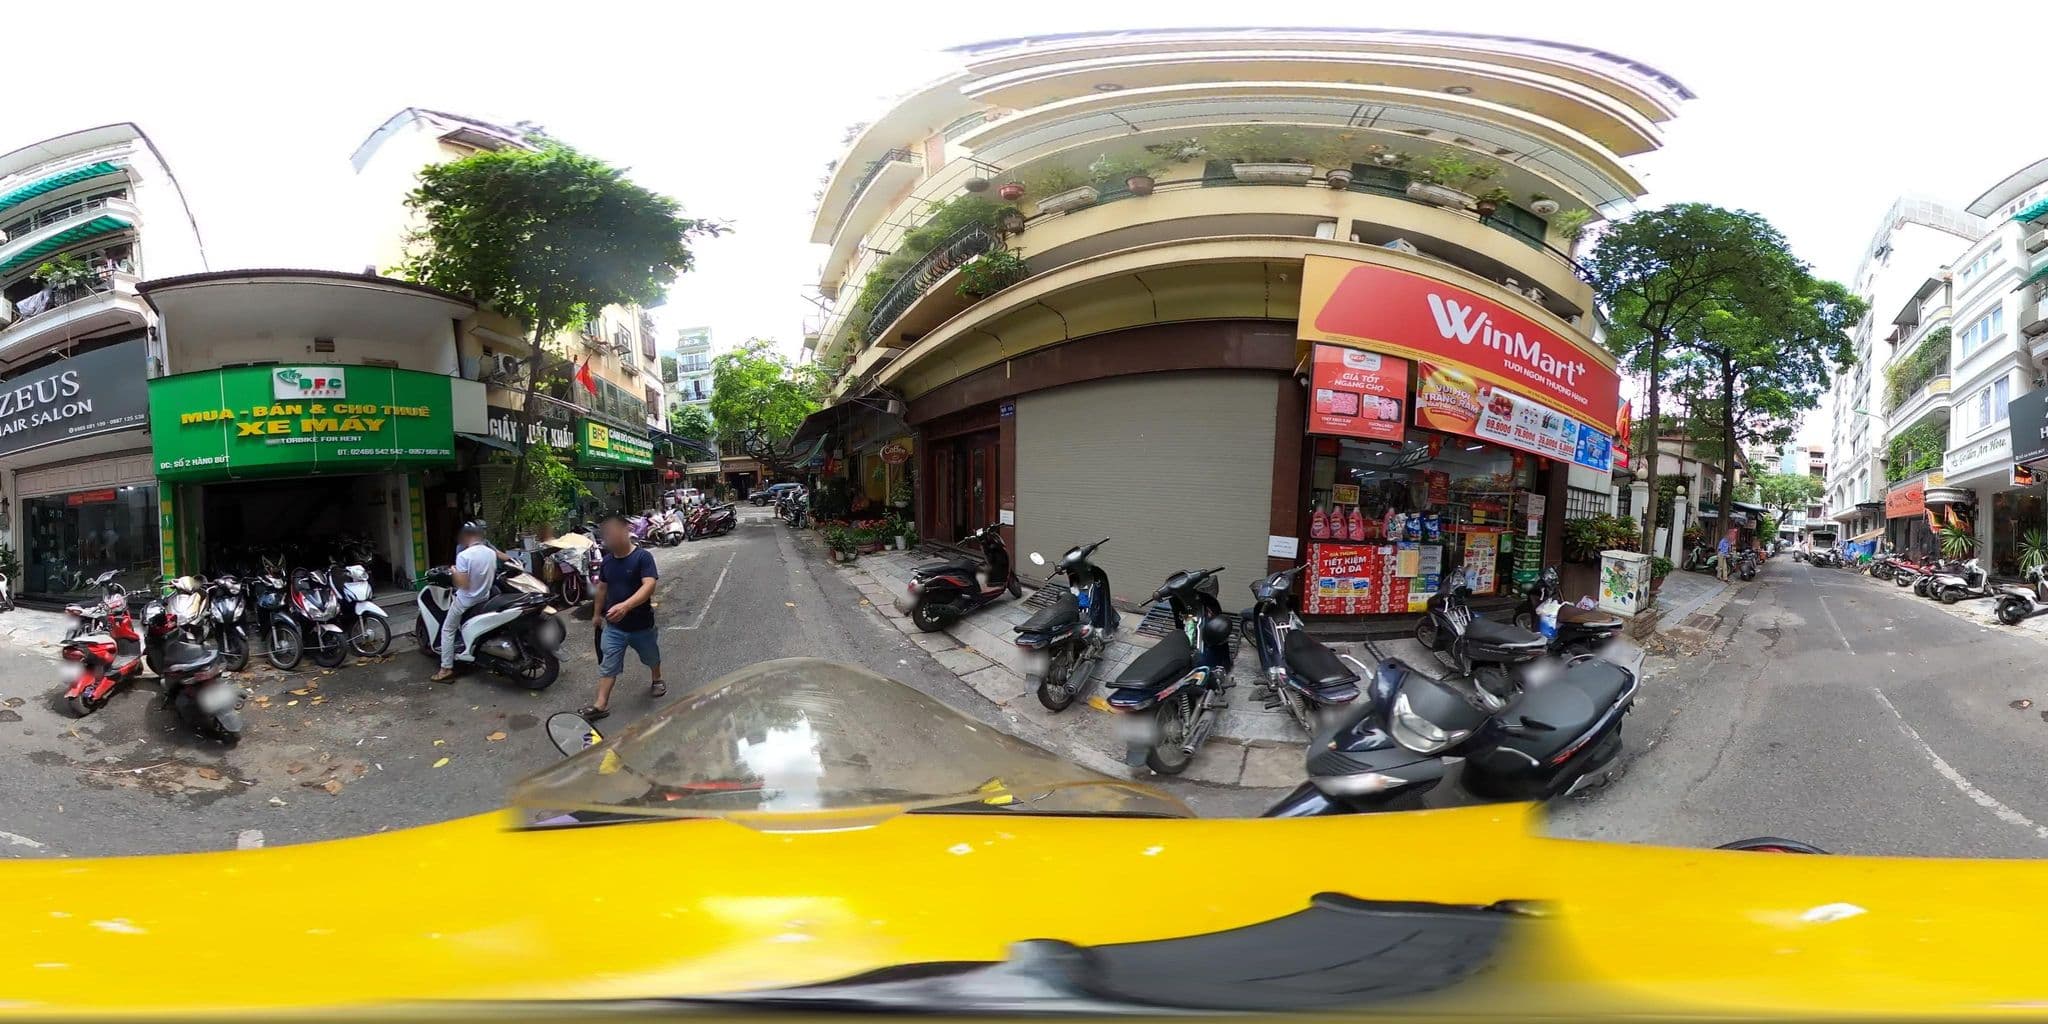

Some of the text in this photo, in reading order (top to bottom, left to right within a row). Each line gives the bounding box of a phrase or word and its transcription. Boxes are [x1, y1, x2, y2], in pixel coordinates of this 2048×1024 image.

[1523, 368, 1546, 384] NGON
[31, 399, 93, 427] SALON
[180, 410, 235, 425] MUA
[252, 402, 303, 417] BÁN
[309, 404, 326, 414] &
[333, 404, 377, 415] CHO
[381, 404, 431, 418] THUÊ
[237, 415, 386, 437] XE MÁY
[174, 458, 184, 468] SỐ
